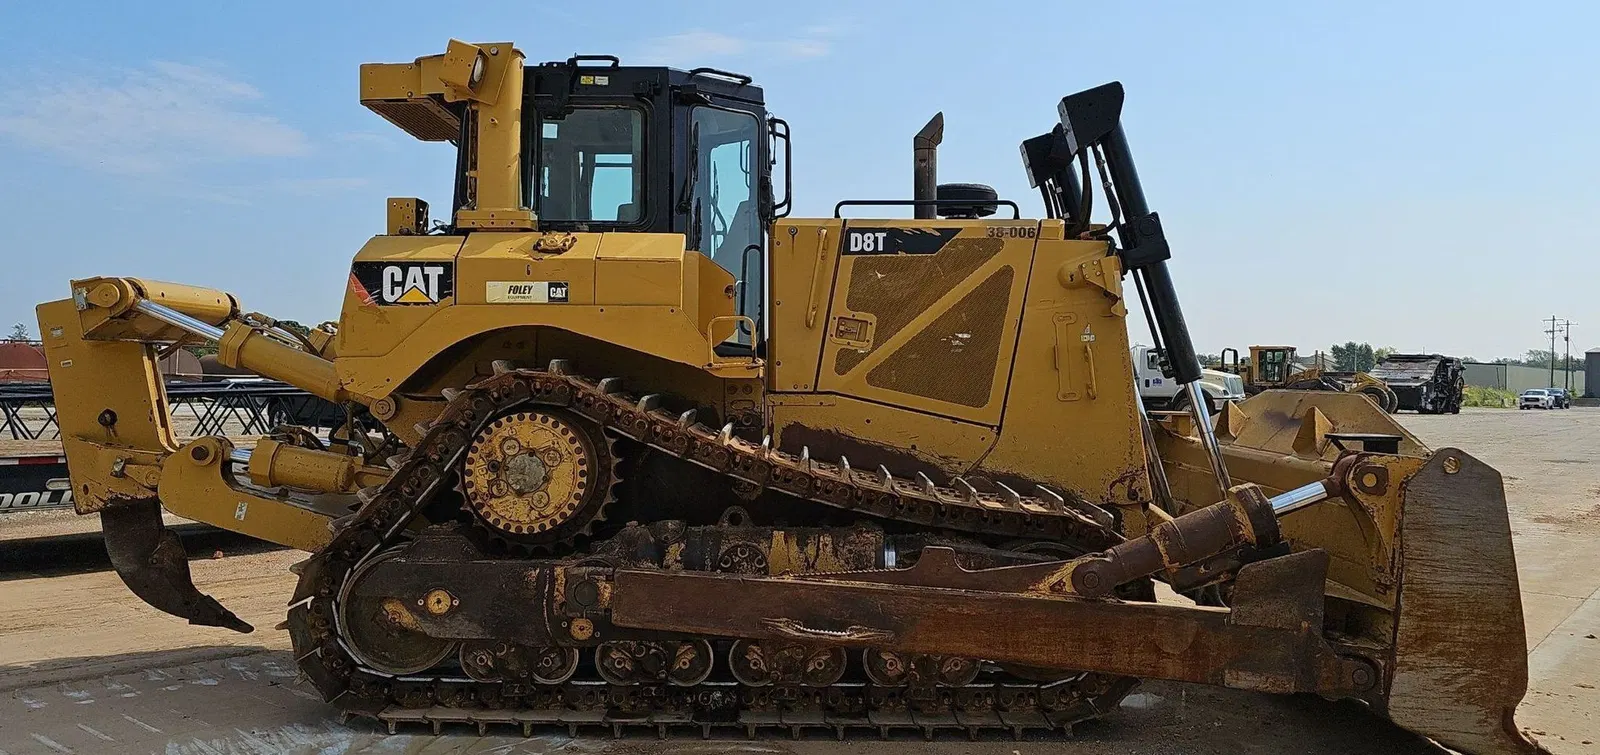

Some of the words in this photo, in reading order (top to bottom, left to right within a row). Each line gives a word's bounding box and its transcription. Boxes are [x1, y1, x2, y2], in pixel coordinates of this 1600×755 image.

[987, 226, 1036, 239] 38-006
[849, 232, 887, 252] D8T
[382, 265, 444, 303] CAT
[507, 285, 534, 295] FOLEY
[549, 287, 567, 298] CAT
